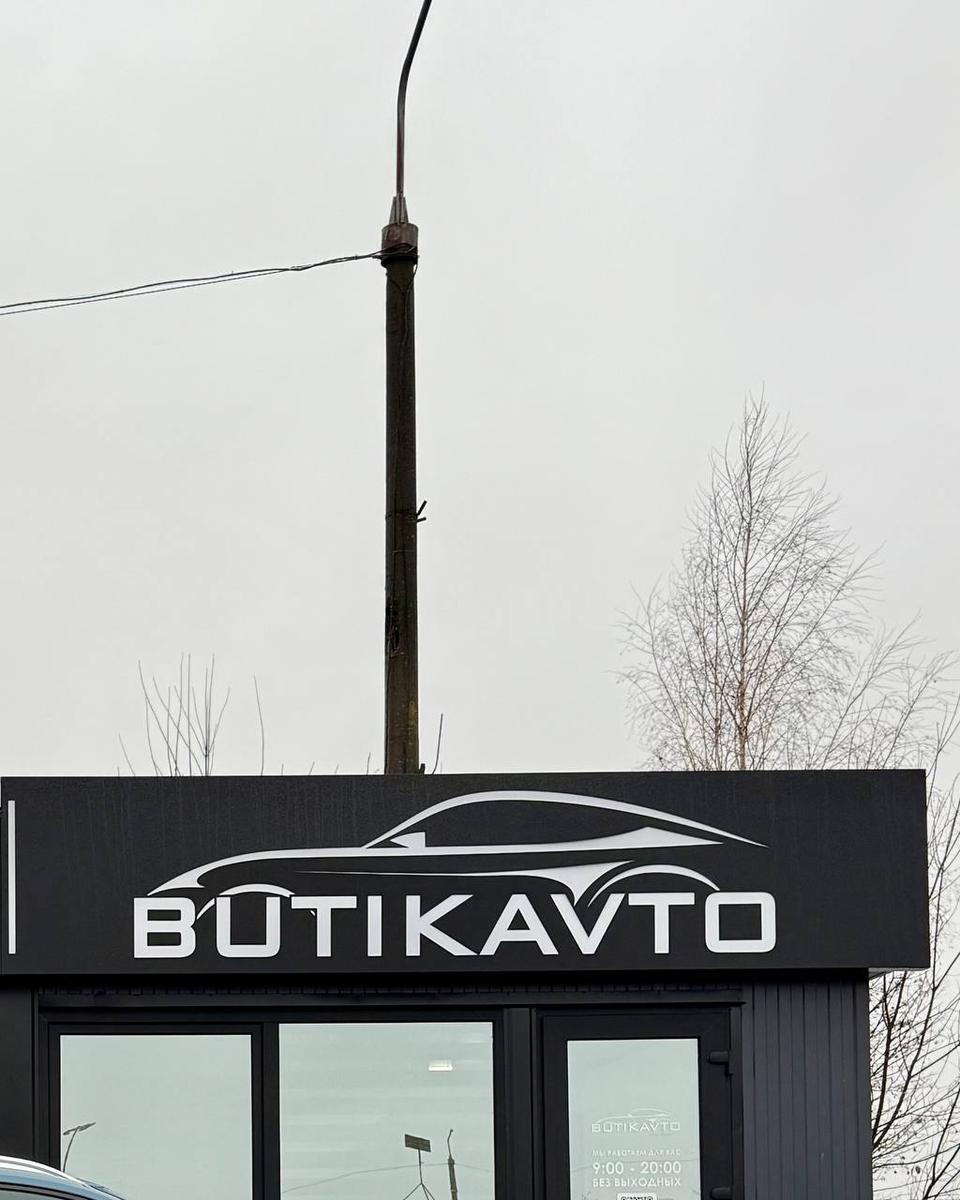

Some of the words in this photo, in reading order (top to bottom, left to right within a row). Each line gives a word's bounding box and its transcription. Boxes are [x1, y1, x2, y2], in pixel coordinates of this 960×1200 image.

[133, 890, 776, 959] BUTIKAVTO
[592, 1122, 680, 1133] BUTIKAVTO
[592, 1161, 624, 1175] 9:00
[640, 1161, 681, 1174] 20:00
[592, 1178, 610, 1188] БЕЗ
[614, 1177, 681, 1187] ВЫХОДНЫХ
